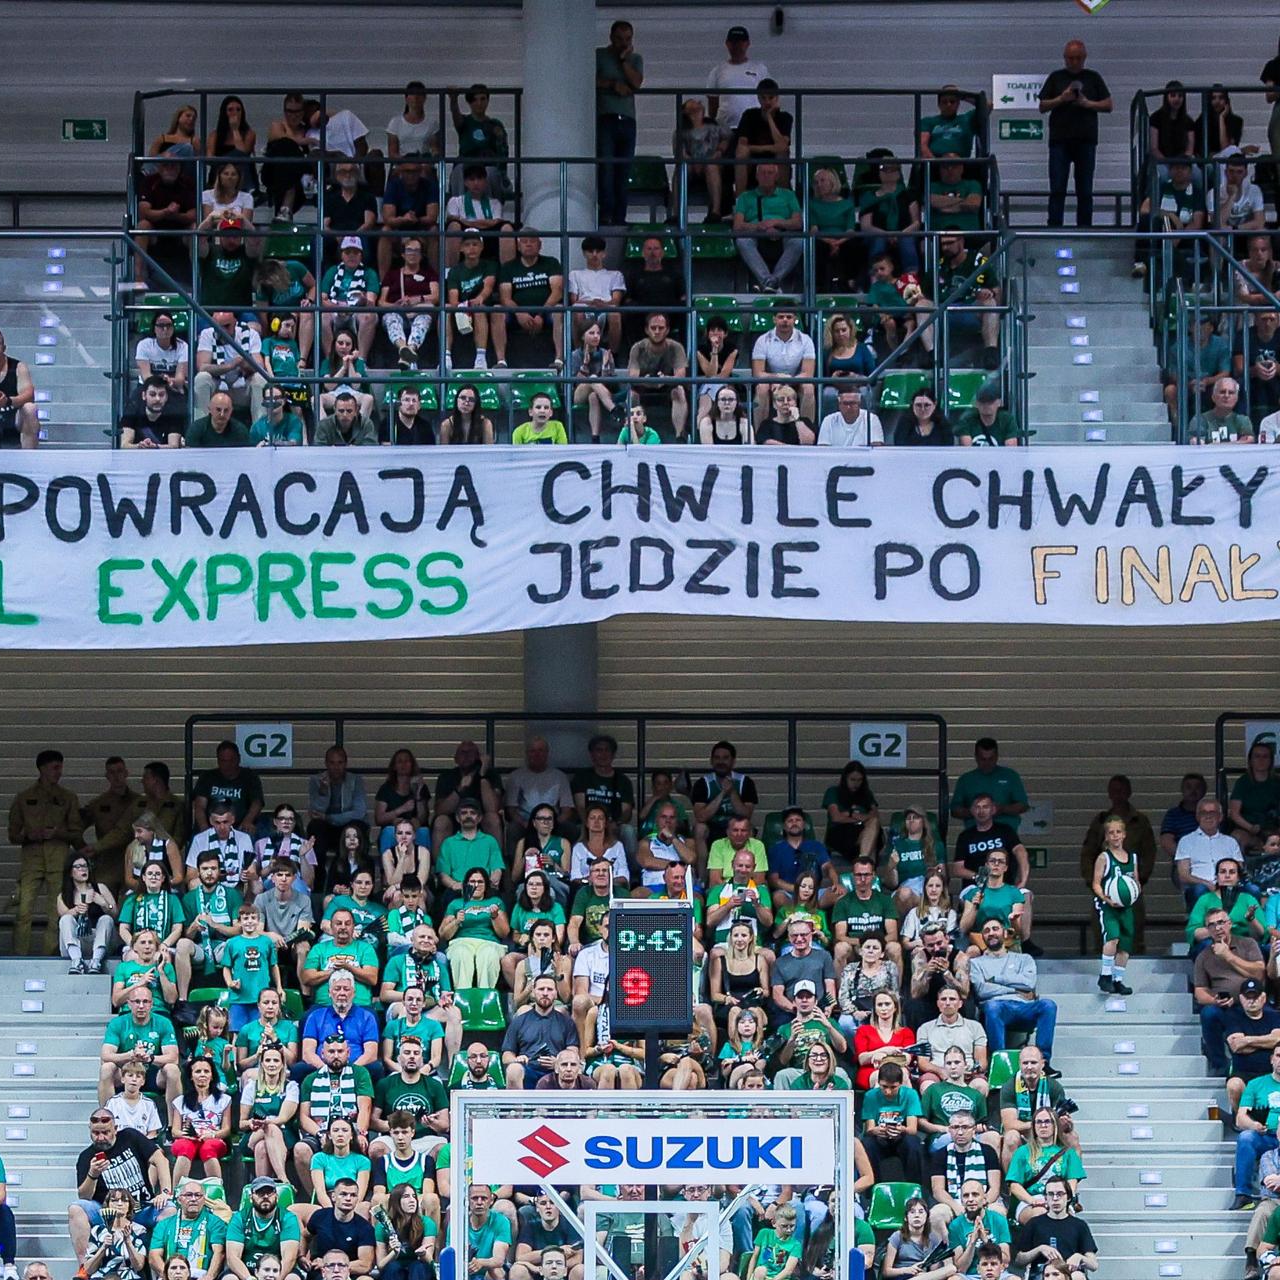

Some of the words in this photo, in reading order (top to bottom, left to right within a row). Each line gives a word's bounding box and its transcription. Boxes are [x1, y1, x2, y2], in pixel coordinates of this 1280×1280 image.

[541, 461, 874, 528] CHWILE
[932, 463, 1268, 529] CHWAŁY
[98, 550, 468, 625] EXPRESS
[526, 536, 820, 603] JEDZIE
[874, 542, 980, 600] PO
[243, 733, 287, 758] G2
[858, 733, 902, 758] G2
[968, 837, 1003, 854] BOSS
[618, 930, 683, 952] 9:45
[585, 1136, 803, 1169] SUZUKI
